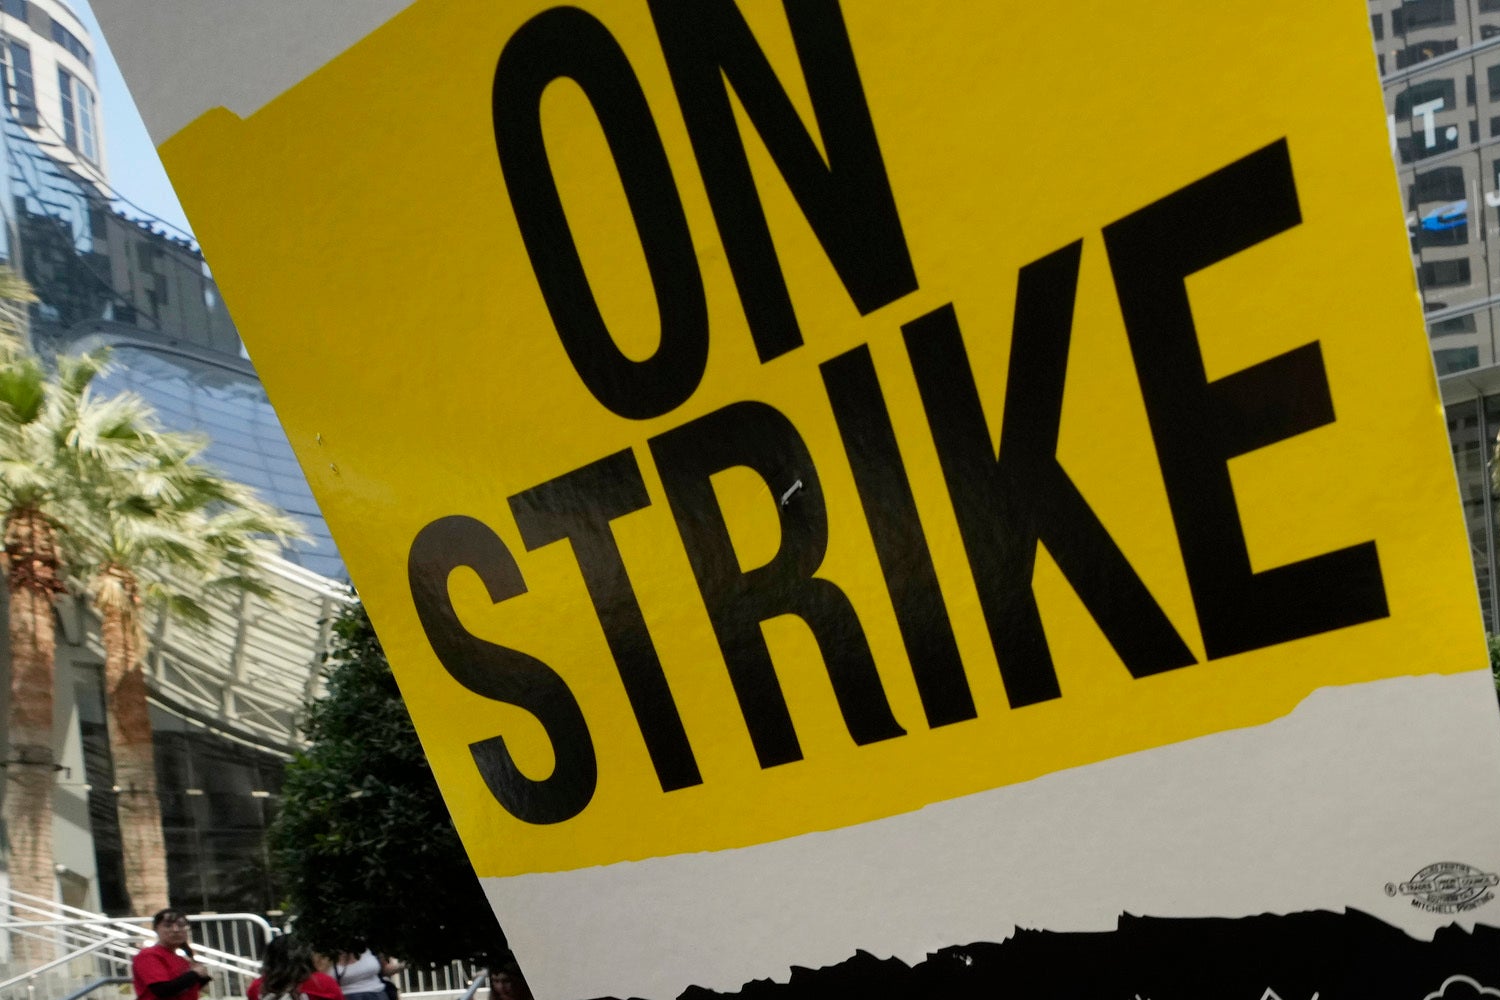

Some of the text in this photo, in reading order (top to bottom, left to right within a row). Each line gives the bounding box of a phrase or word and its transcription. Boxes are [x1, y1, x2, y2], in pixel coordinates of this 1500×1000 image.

[492, 0, 919, 420] ON
[407, 136, 1390, 825] STRIKE
[1411, 898, 1454, 914] MITCHELL
